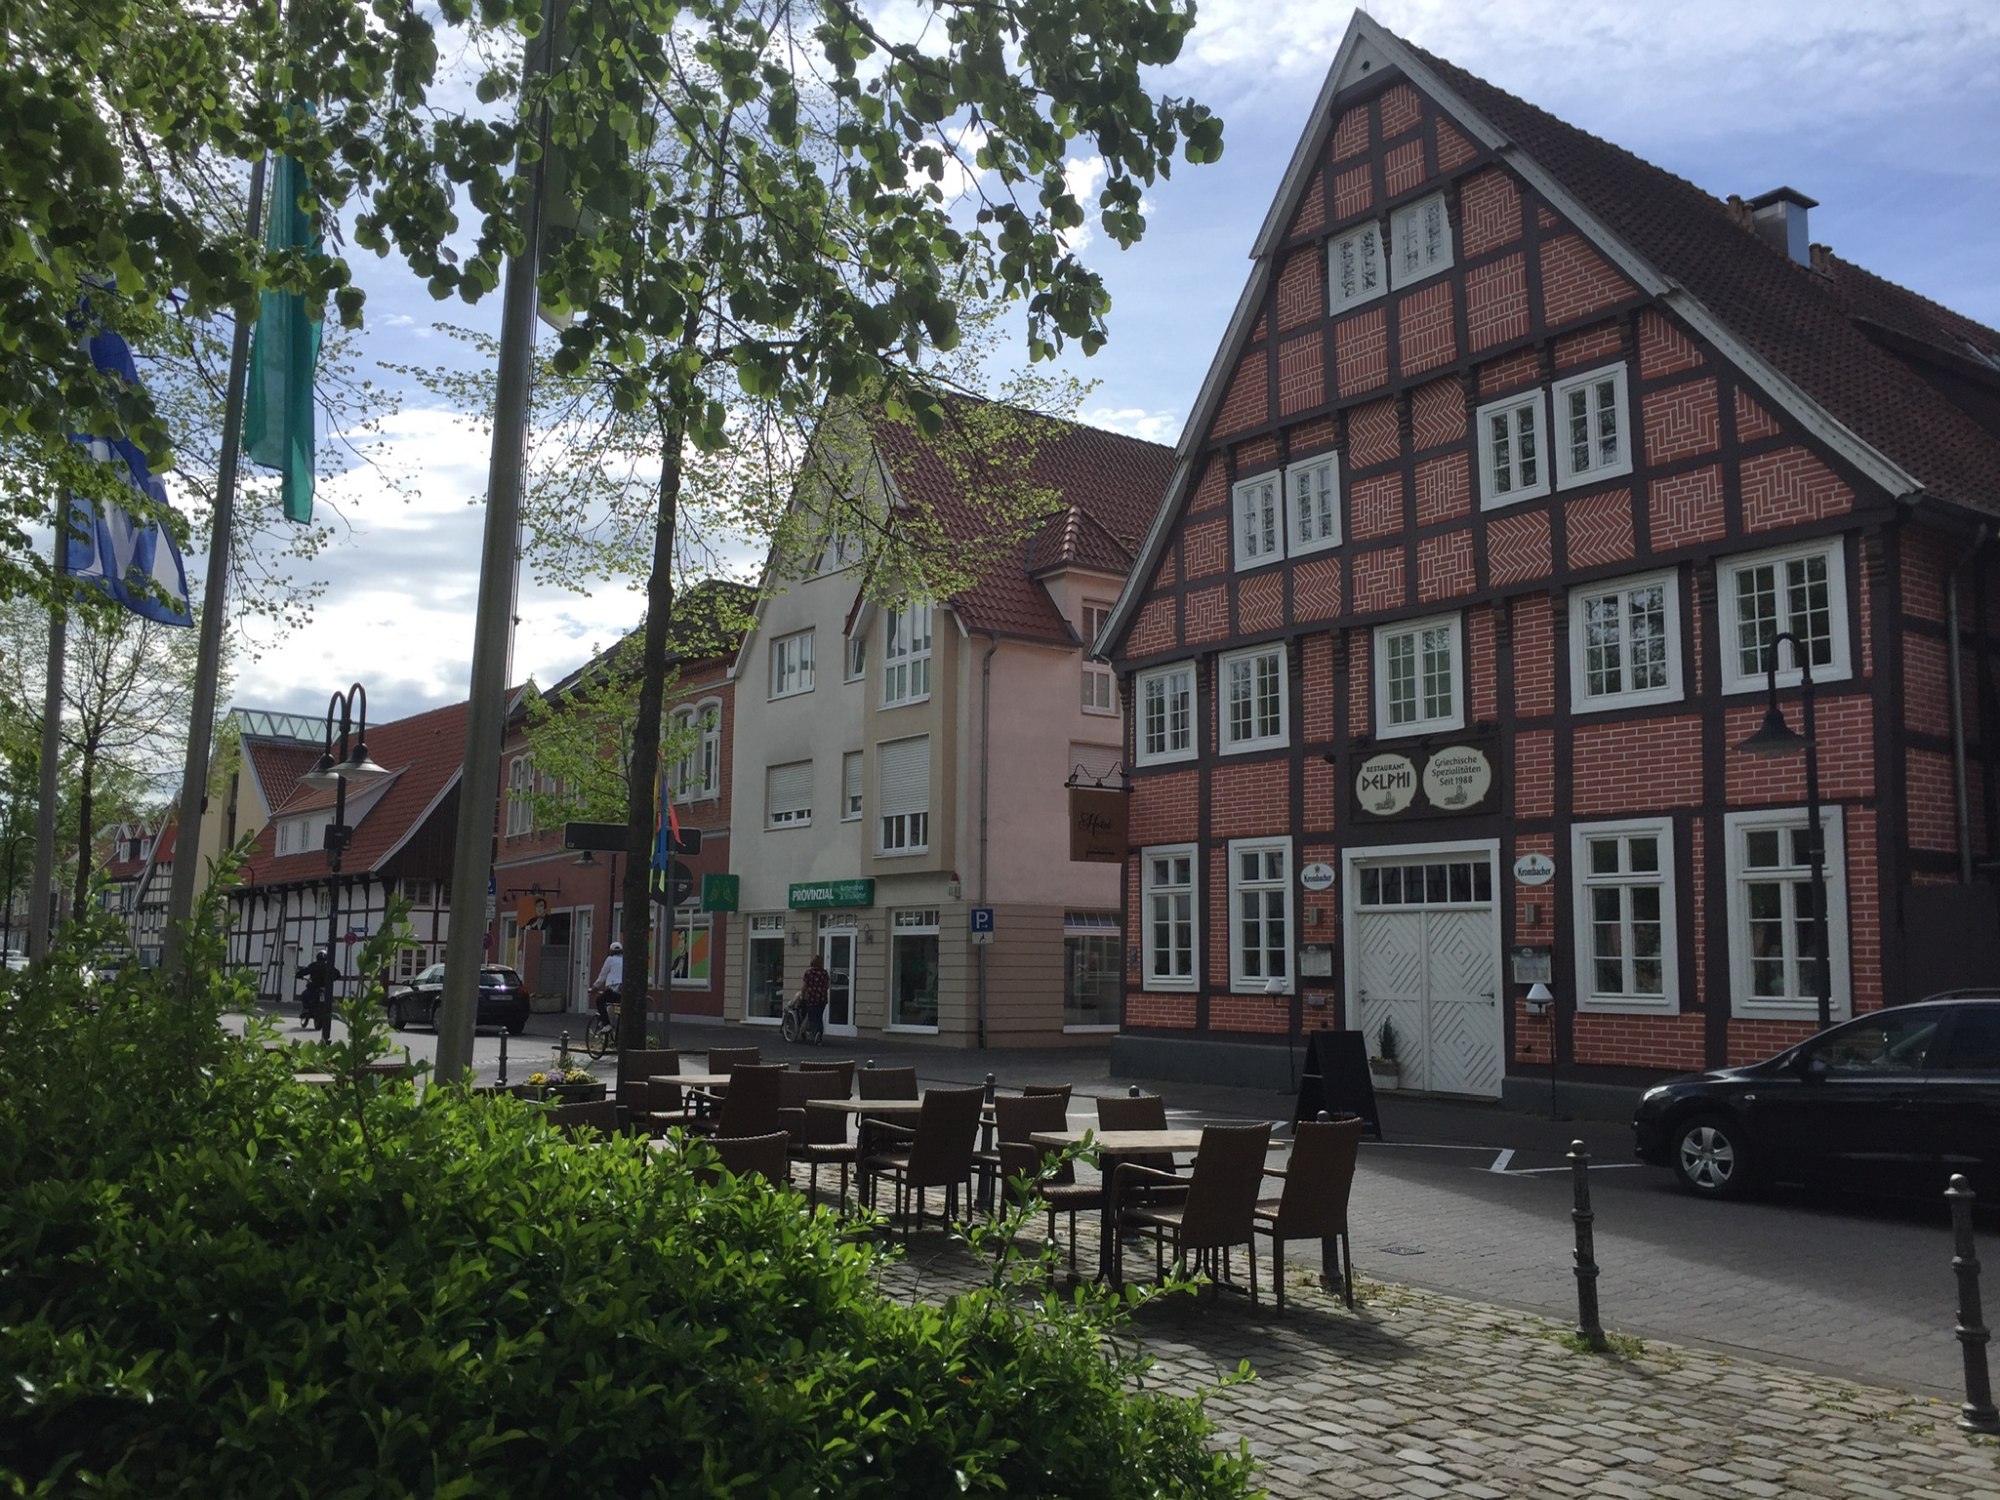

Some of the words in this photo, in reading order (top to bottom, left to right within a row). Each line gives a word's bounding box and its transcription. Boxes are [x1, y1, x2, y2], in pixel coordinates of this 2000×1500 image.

[1435, 756, 1478, 767] Griechische
[1366, 763, 1405, 773] RESTAURANT
[1431, 765, 1482, 778] Spezialitäten
[1362, 772, 1410, 791] DELPHI
[1439, 776, 1454, 786] Seit
[1455, 775, 1473, 785] 1988
[1518, 865, 1551, 877] Krombacher
[1304, 873, 1332, 883] Krombacher
[792, 888, 834, 902] PROVINZIAL
[976, 911, 988, 929] P
